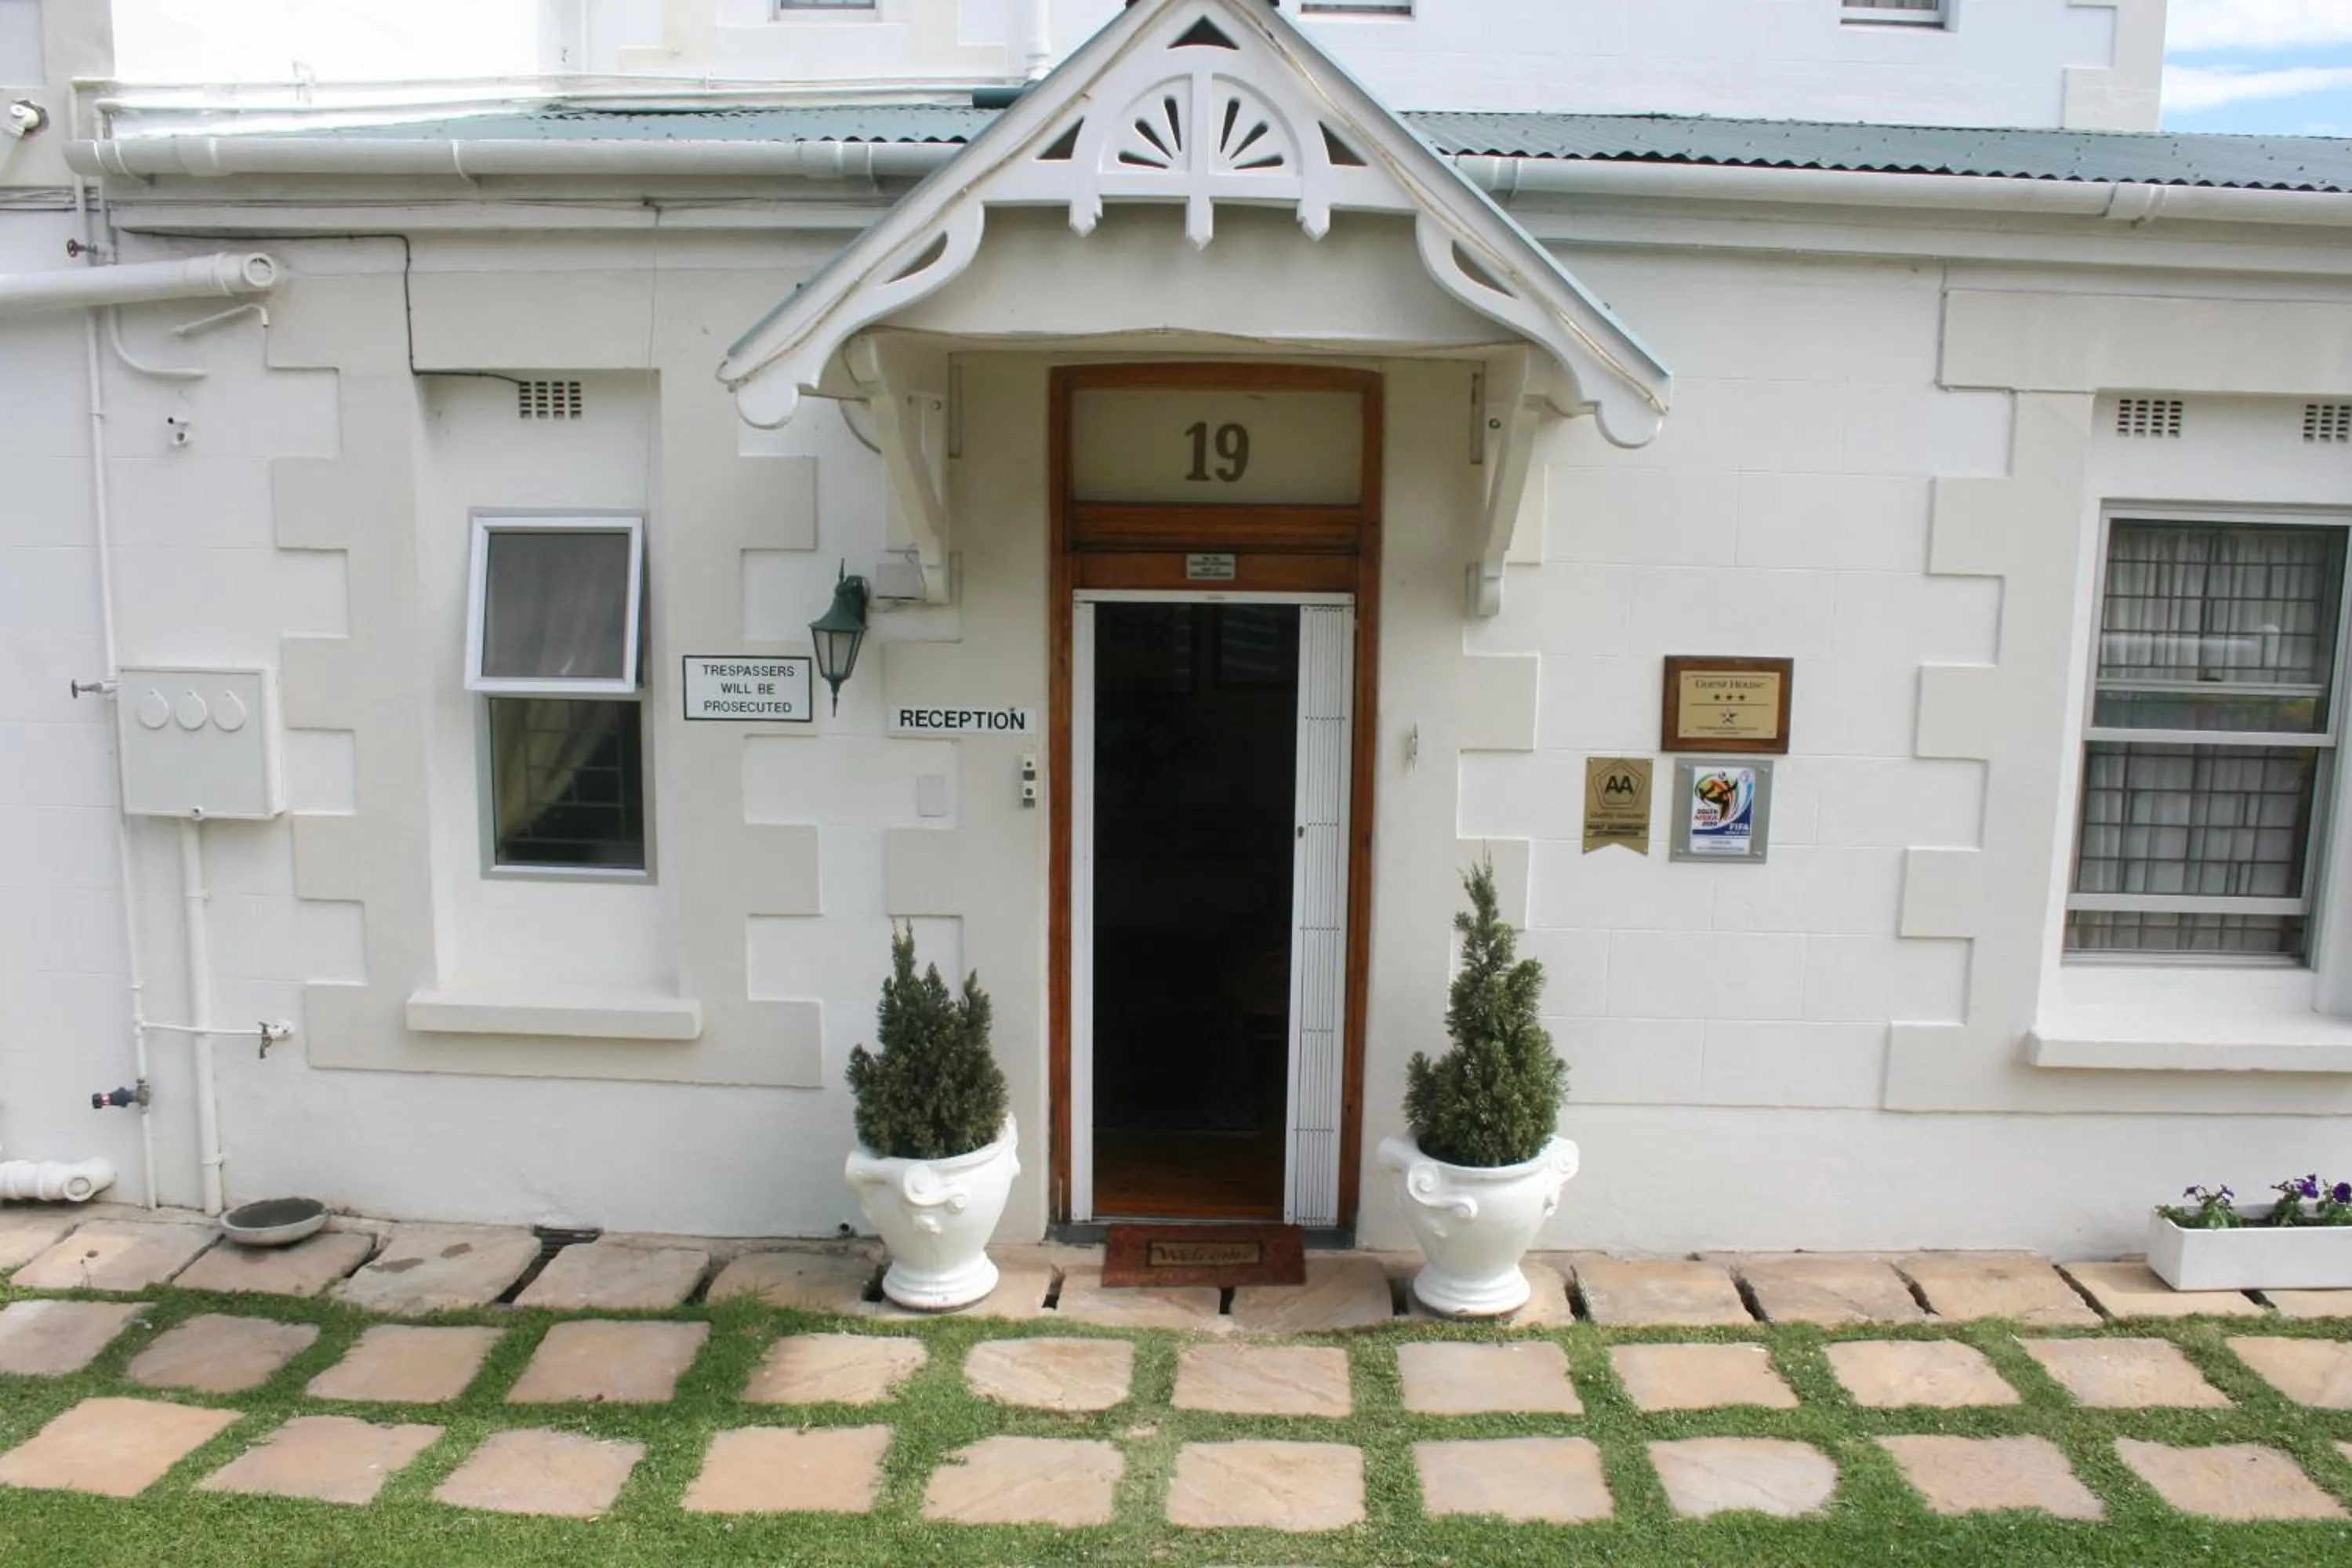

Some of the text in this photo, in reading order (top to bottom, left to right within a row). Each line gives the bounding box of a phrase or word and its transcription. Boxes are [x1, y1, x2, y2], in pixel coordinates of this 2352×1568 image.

[1184, 421, 1250, 482] 19
[702, 664, 795, 677] TRESPASSERS
[720, 683, 776, 695] WILL BE
[1695, 680, 1766, 689] Guest House
[703, 700, 793, 713] PROSECUTED
[899, 709, 1025, 730] RECEPTION
[1605, 775, 1633, 794] AA
